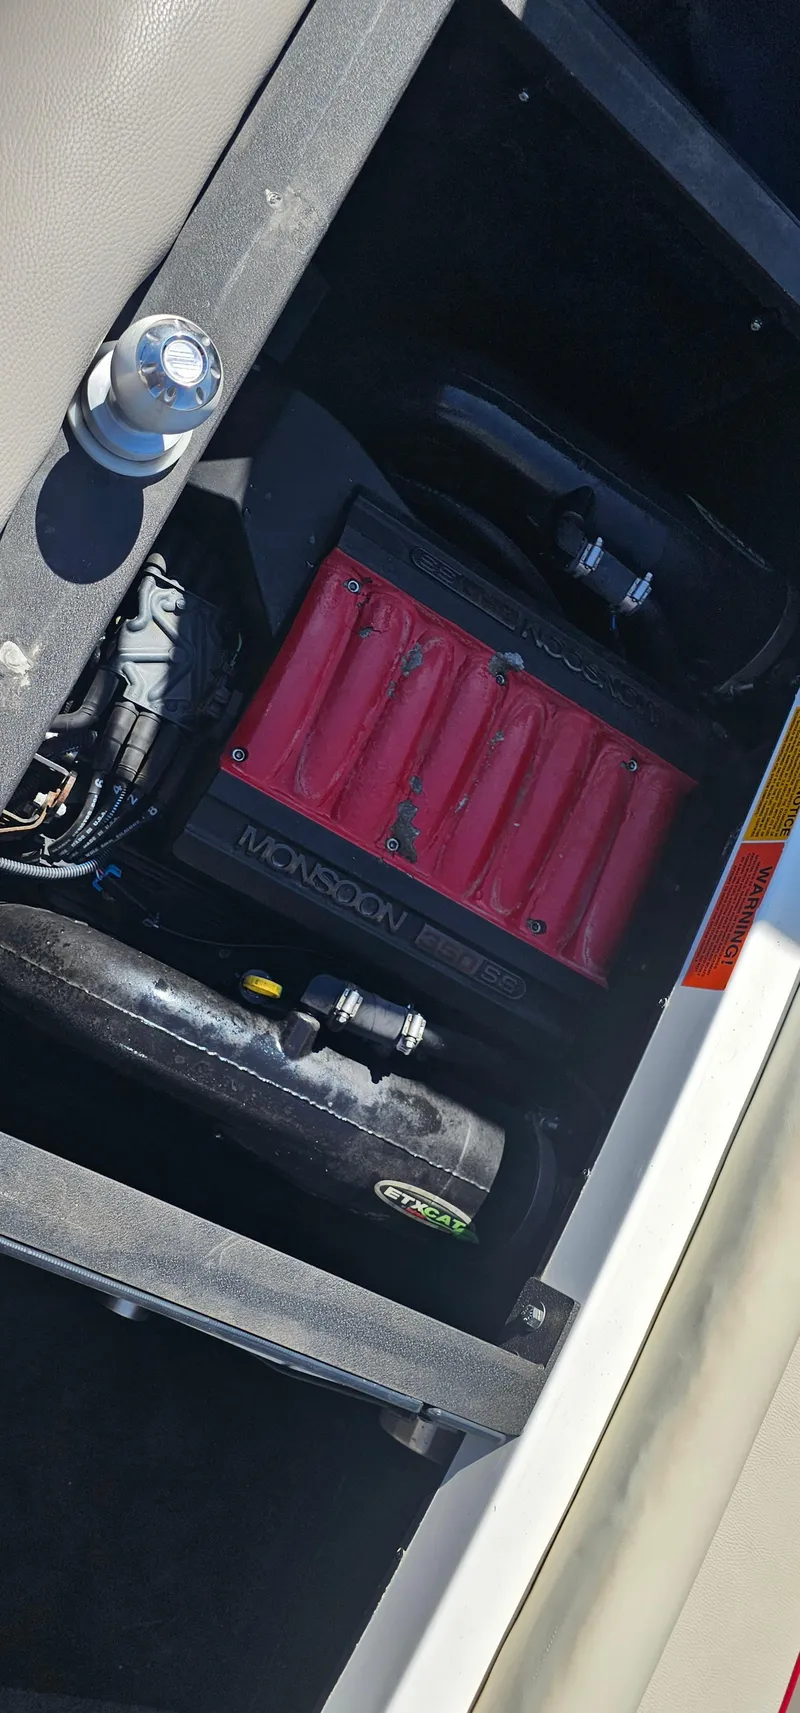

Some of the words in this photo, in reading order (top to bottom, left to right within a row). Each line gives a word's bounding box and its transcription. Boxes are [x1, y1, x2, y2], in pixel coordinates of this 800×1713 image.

[94, 778, 104, 789] 6
[113, 784, 123, 795] 4
[127, 794, 139, 806] 2
[147, 805, 159, 816] 8
[238, 825, 408, 933] MONSOON
[481, 965, 519, 994] SS
[721, 866, 773, 966] WARNING!
[384, 1186, 467, 1233] ETXCAT
